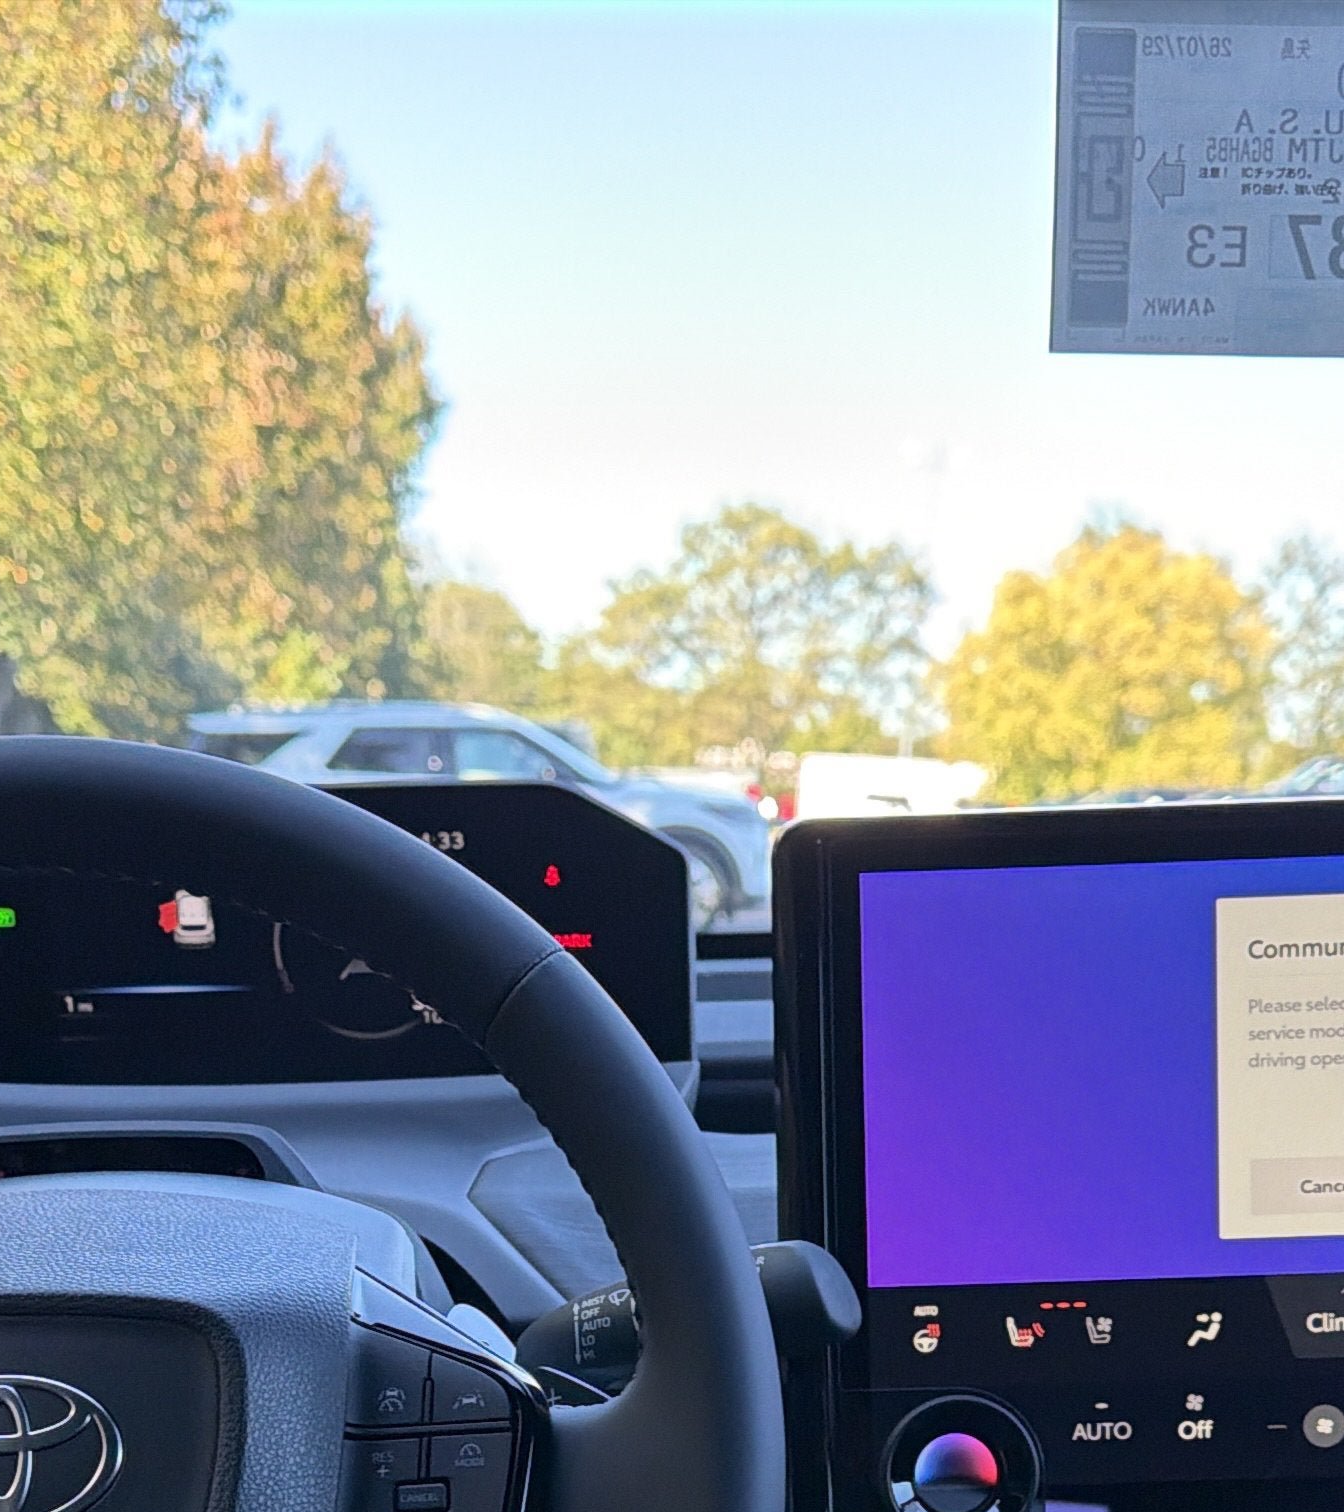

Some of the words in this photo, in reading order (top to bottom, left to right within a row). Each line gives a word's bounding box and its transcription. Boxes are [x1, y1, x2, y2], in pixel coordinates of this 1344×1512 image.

[1248, 997, 1302, 1014] Please
[1248, 1024, 1305, 1041] service
[1248, 1052, 1306, 1070] driving
[582, 1317, 611, 1332] AUTO
[1071, 1421, 1133, 1441] AUTO
[1177, 1420, 1214, 1440] Off
